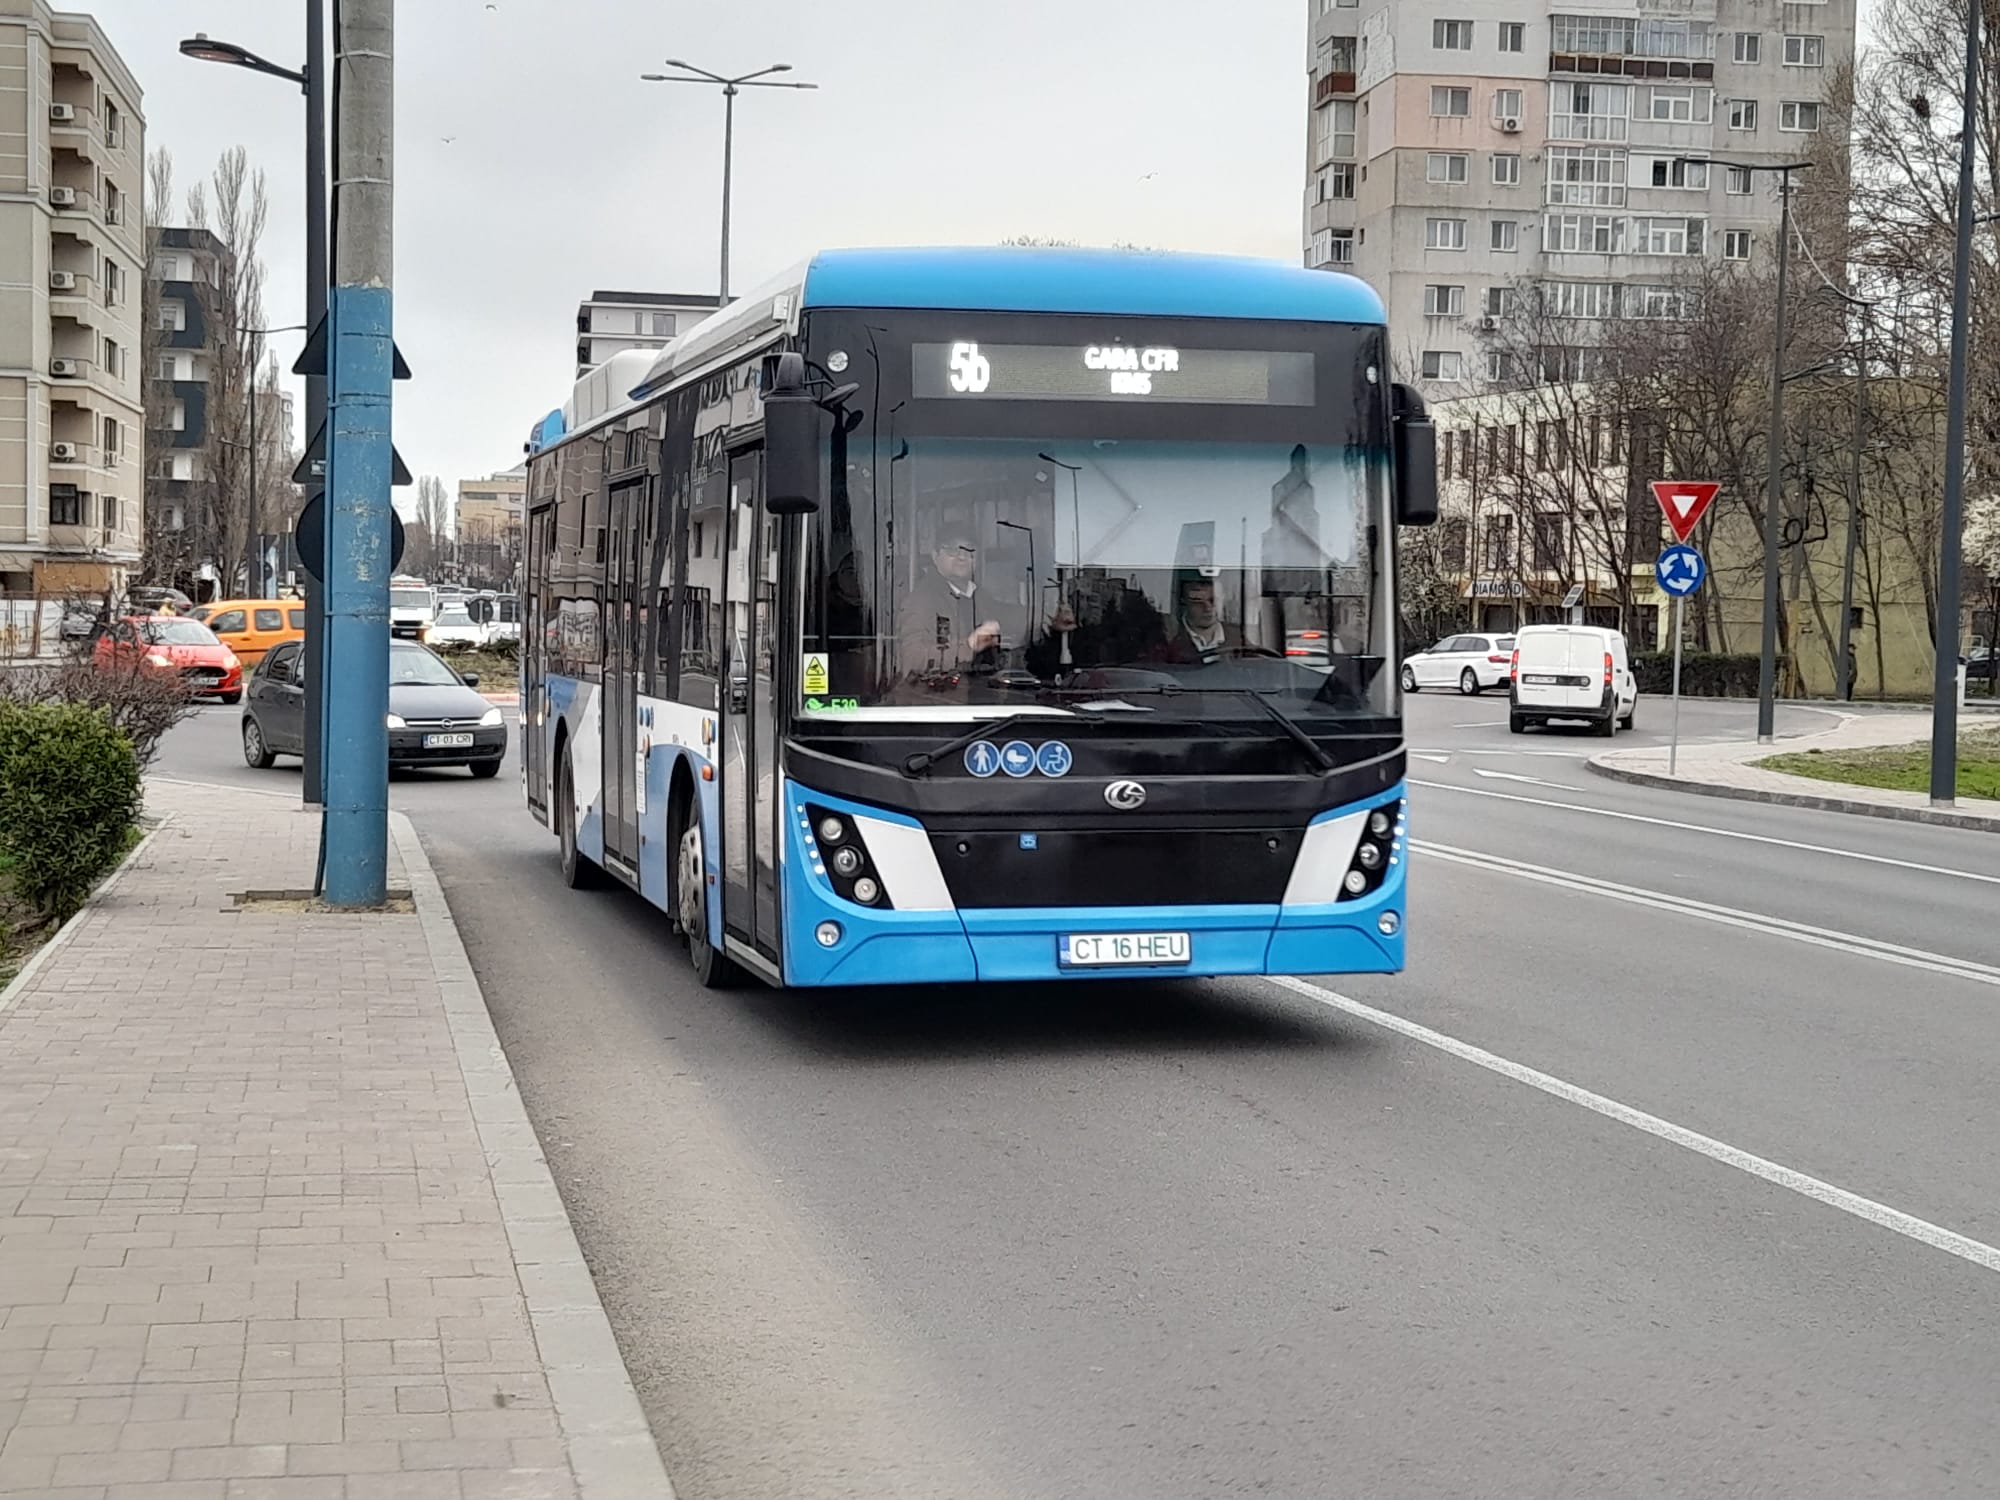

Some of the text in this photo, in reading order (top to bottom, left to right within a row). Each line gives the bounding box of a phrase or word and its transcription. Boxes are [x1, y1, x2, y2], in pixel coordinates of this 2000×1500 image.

[1141, 349, 1179, 372] CFR
[429, 735, 440, 745] CT
[443, 735, 454, 744] 03
[1074, 935, 1185, 960] CT 16 HEU
